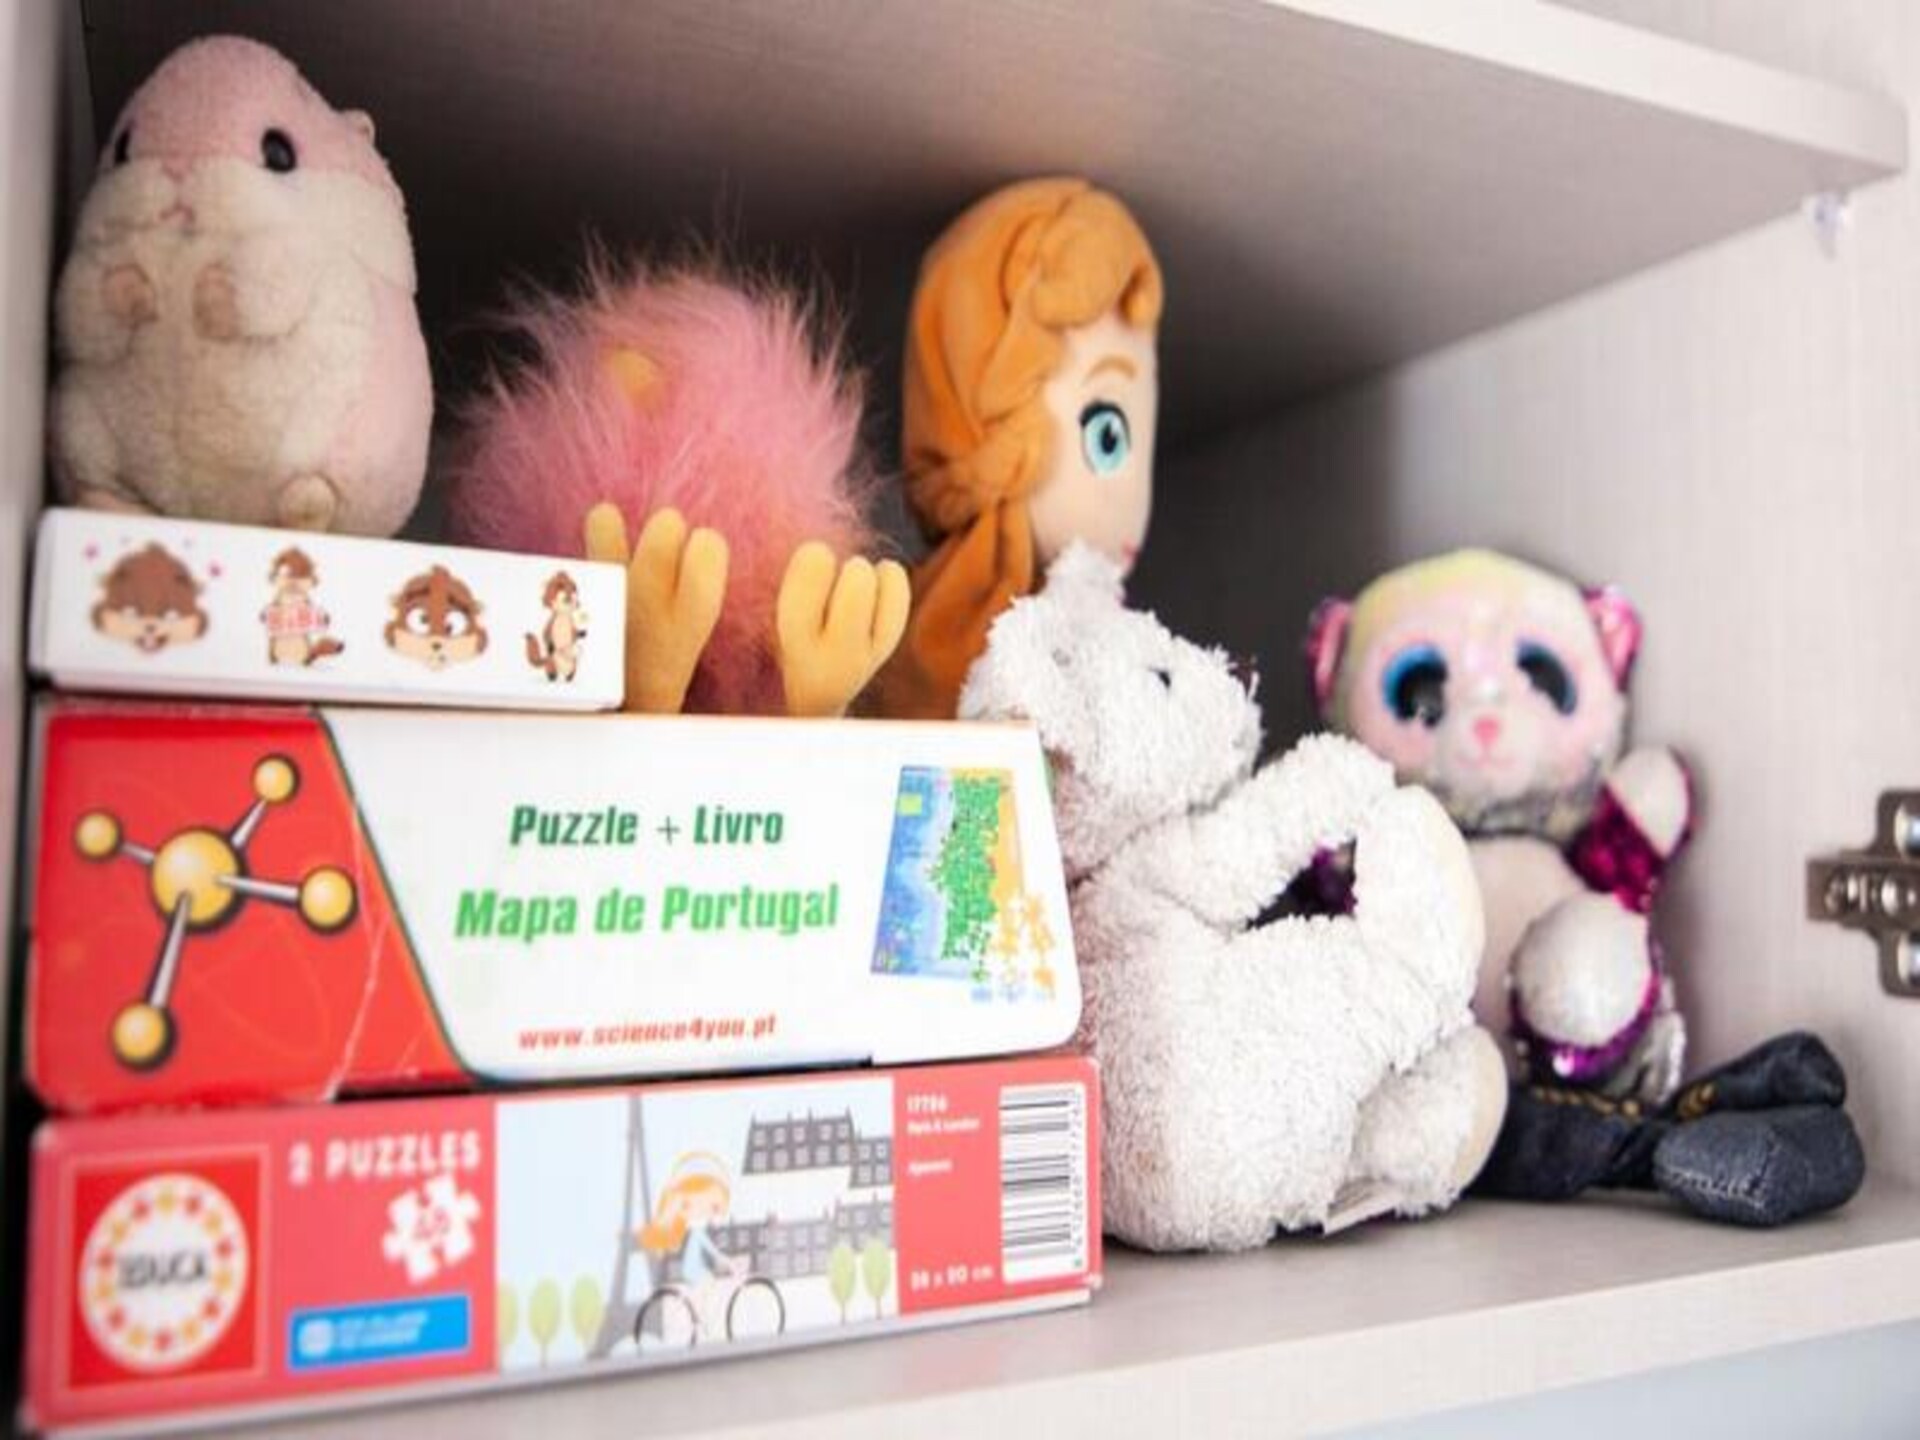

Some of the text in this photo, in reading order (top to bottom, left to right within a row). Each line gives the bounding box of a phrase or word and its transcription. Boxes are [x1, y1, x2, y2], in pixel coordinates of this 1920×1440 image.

[510, 804, 784, 846] Puzzle + Livro
[454, 882, 839, 942] Mapa de Portugal
[518, 1013, 777, 1050] www.science4you.pt
[325, 1130, 481, 1180] PUZZLES
